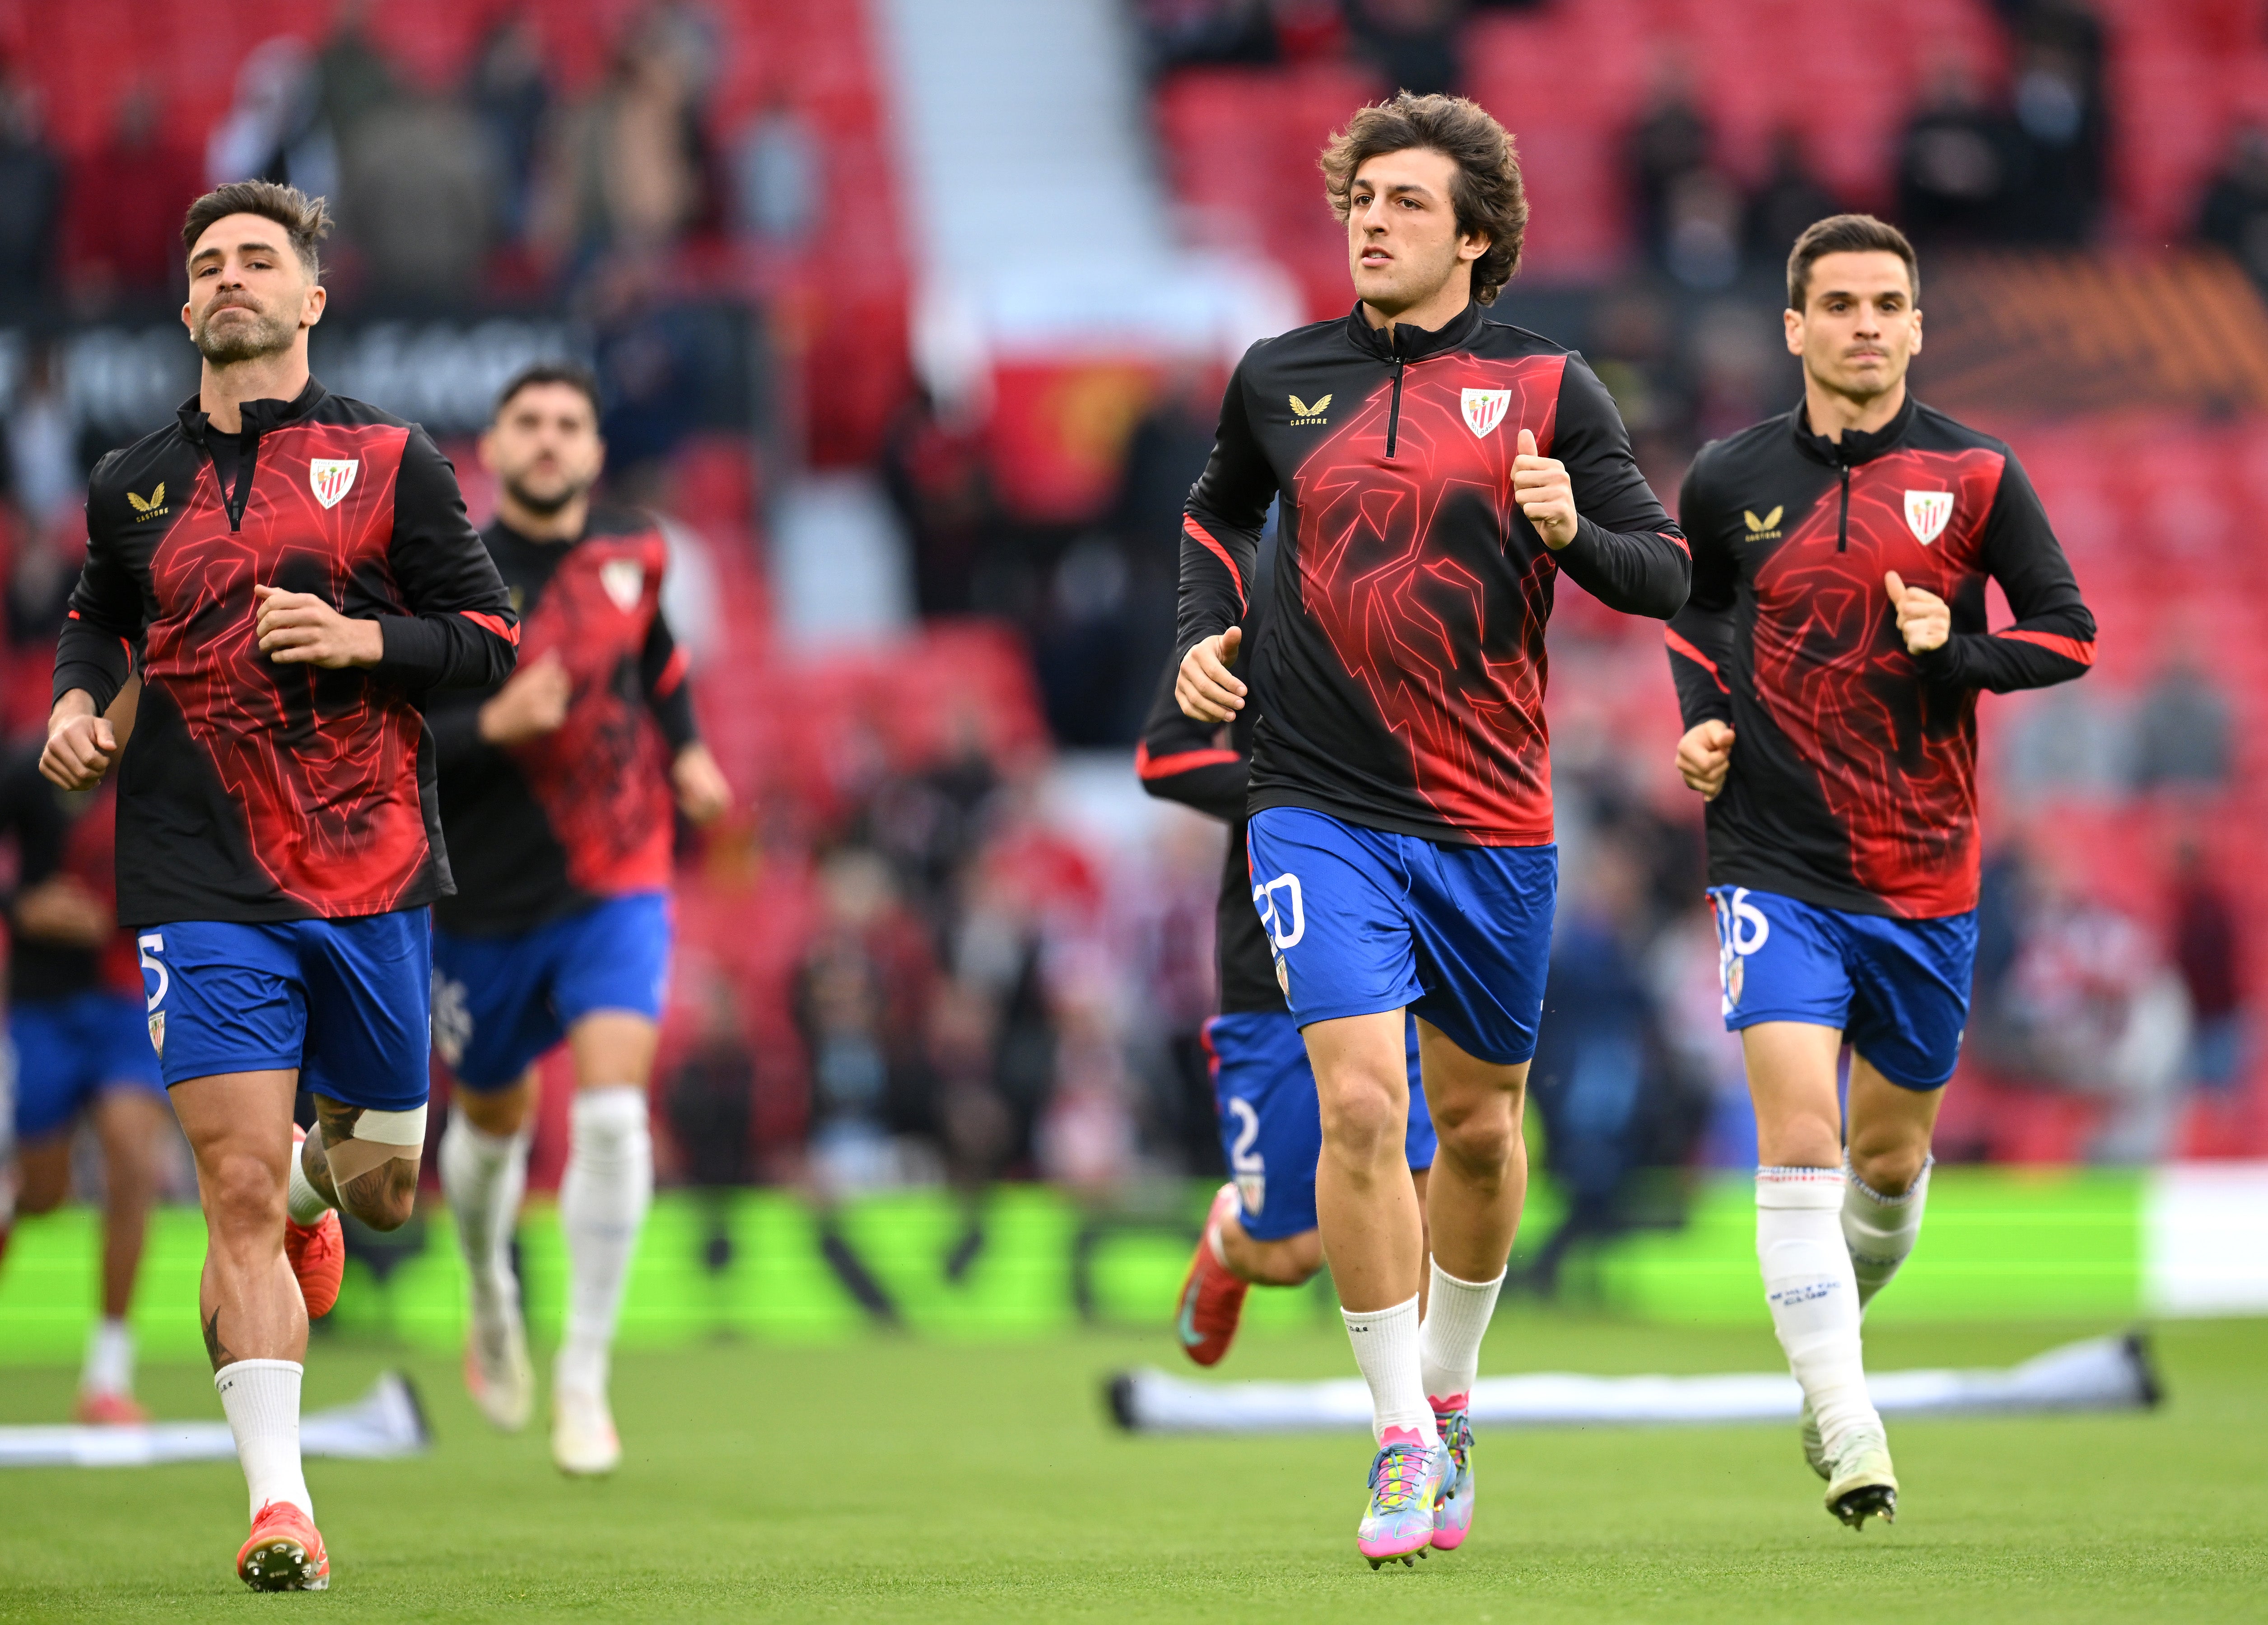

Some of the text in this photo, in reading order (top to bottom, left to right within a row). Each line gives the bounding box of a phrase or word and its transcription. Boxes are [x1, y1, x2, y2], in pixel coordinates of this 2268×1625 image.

[1290, 418, 1327, 426] CASTORE
[1471, 422, 1493, 436] BILBAO
[319, 493, 340, 507] BILBAO
[136, 507, 169, 523] CASTORE
[1253, 873, 1305, 958] 20
[138, 933, 168, 1013] 5
[1228, 1096, 1264, 1173] 2
